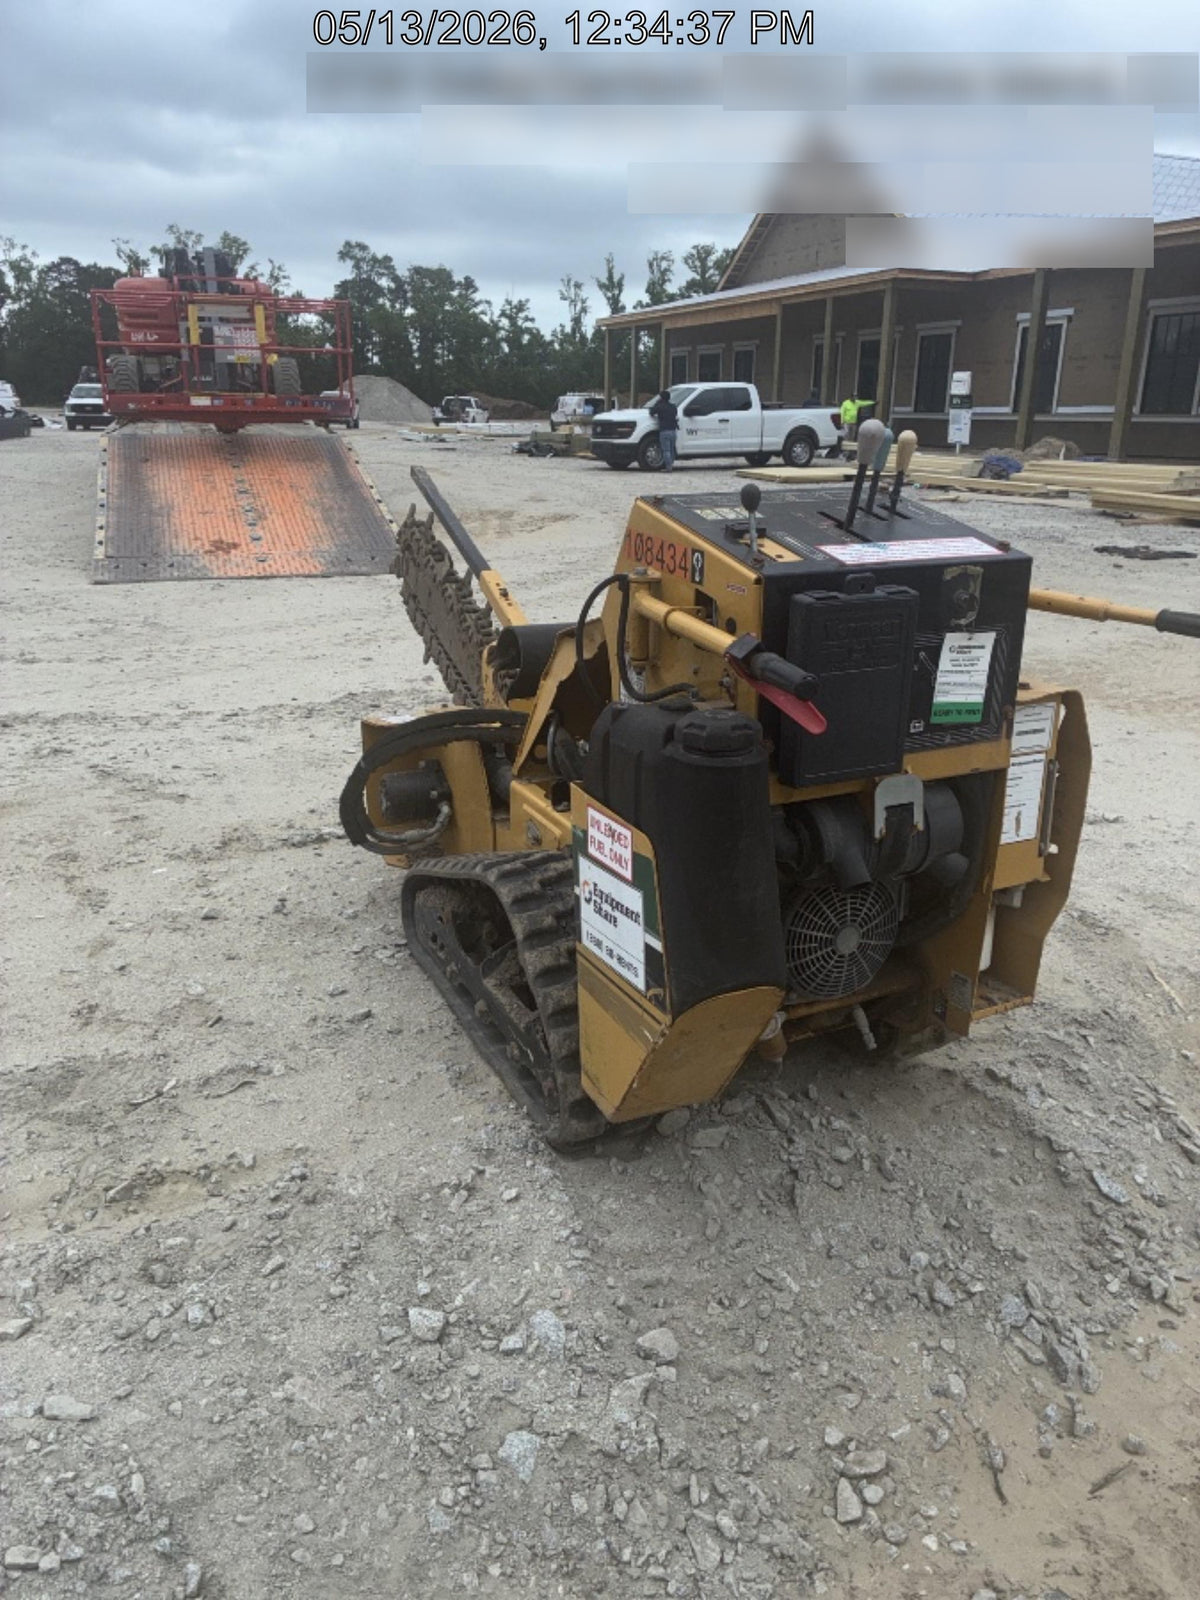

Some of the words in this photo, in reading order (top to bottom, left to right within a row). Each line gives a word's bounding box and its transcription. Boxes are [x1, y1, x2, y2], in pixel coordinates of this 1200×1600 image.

[626, 528, 689, 579] 108434
[589, 835, 608, 858] FUEL
[609, 846, 630, 871] ONLY
[592, 881, 642, 926] Equipment
[592, 900, 618, 928] Share
